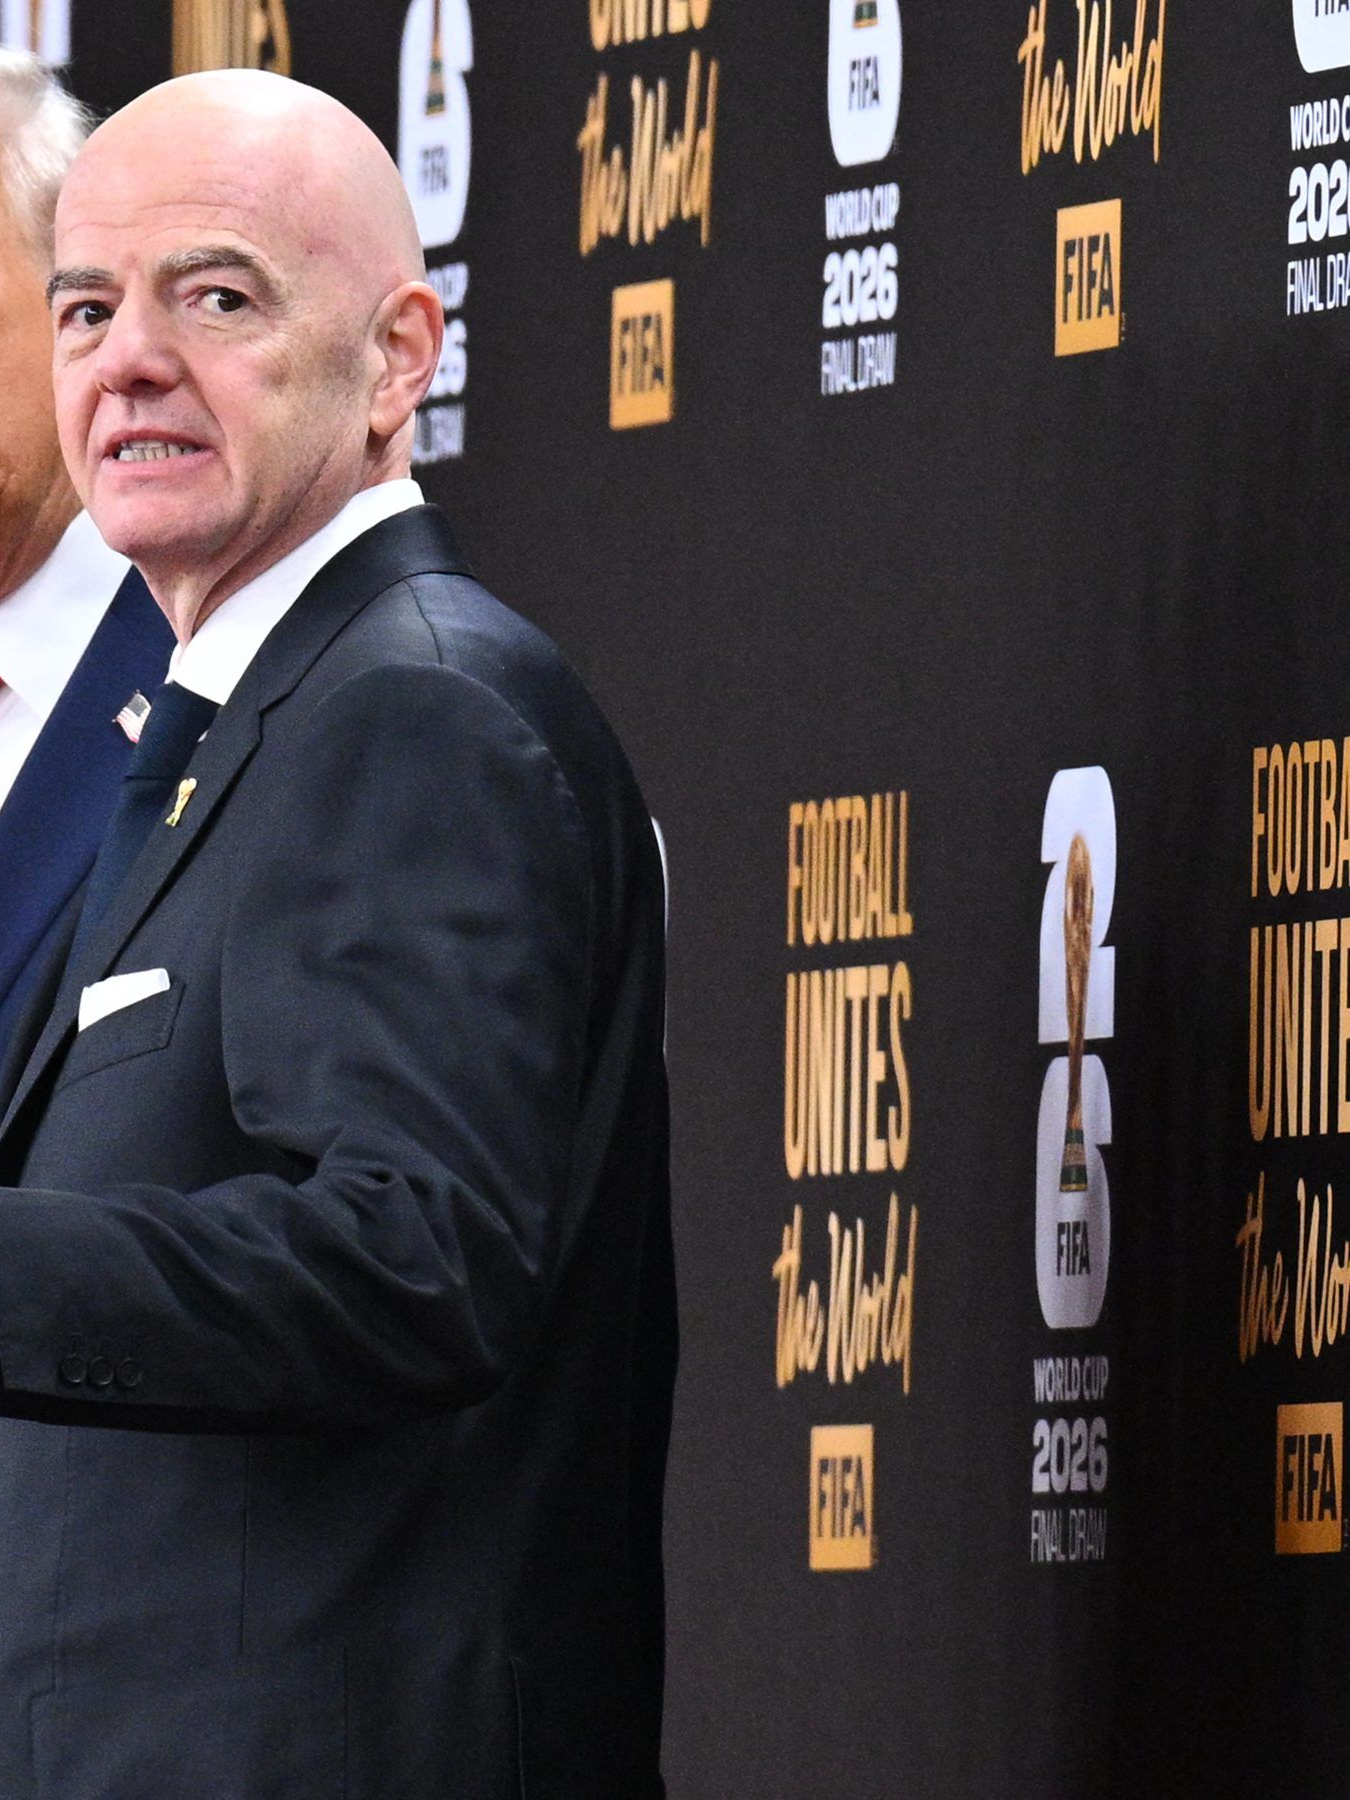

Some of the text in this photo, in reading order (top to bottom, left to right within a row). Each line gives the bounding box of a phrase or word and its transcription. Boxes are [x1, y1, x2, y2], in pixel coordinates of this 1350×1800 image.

[849, 56, 879, 110] FIFA
[1018, 0, 1166, 175] the World
[1289, 98, 1340, 151] WORLD
[825, 182, 900, 240] WORLD CUP
[1287, 159, 1350, 245] 202
[822, 242, 898, 328] 2026
[1063, 232, 1114, 323] FIFA
[1287, 256, 1324, 316] FINAL
[619, 314, 665, 394] FIFA
[821, 331, 897, 396] FINAL DRAW
[787, 790, 913, 947] FOOTBALL
[784, 961, 912, 1179] UNITES
[1056, 1221, 1091, 1276] FIFA
[1235, 1170, 1290, 1365] the
[772, 1192, 919, 1395] the World
[1033, 1355, 1109, 1402] WORLD CUP
[1032, 1416, 1108, 1493] 2026
[1282, 1433, 1337, 1522] FIFA
[818, 1456, 866, 1538] FIFA
[1031, 1507, 1107, 1563] FINAL DRAW
